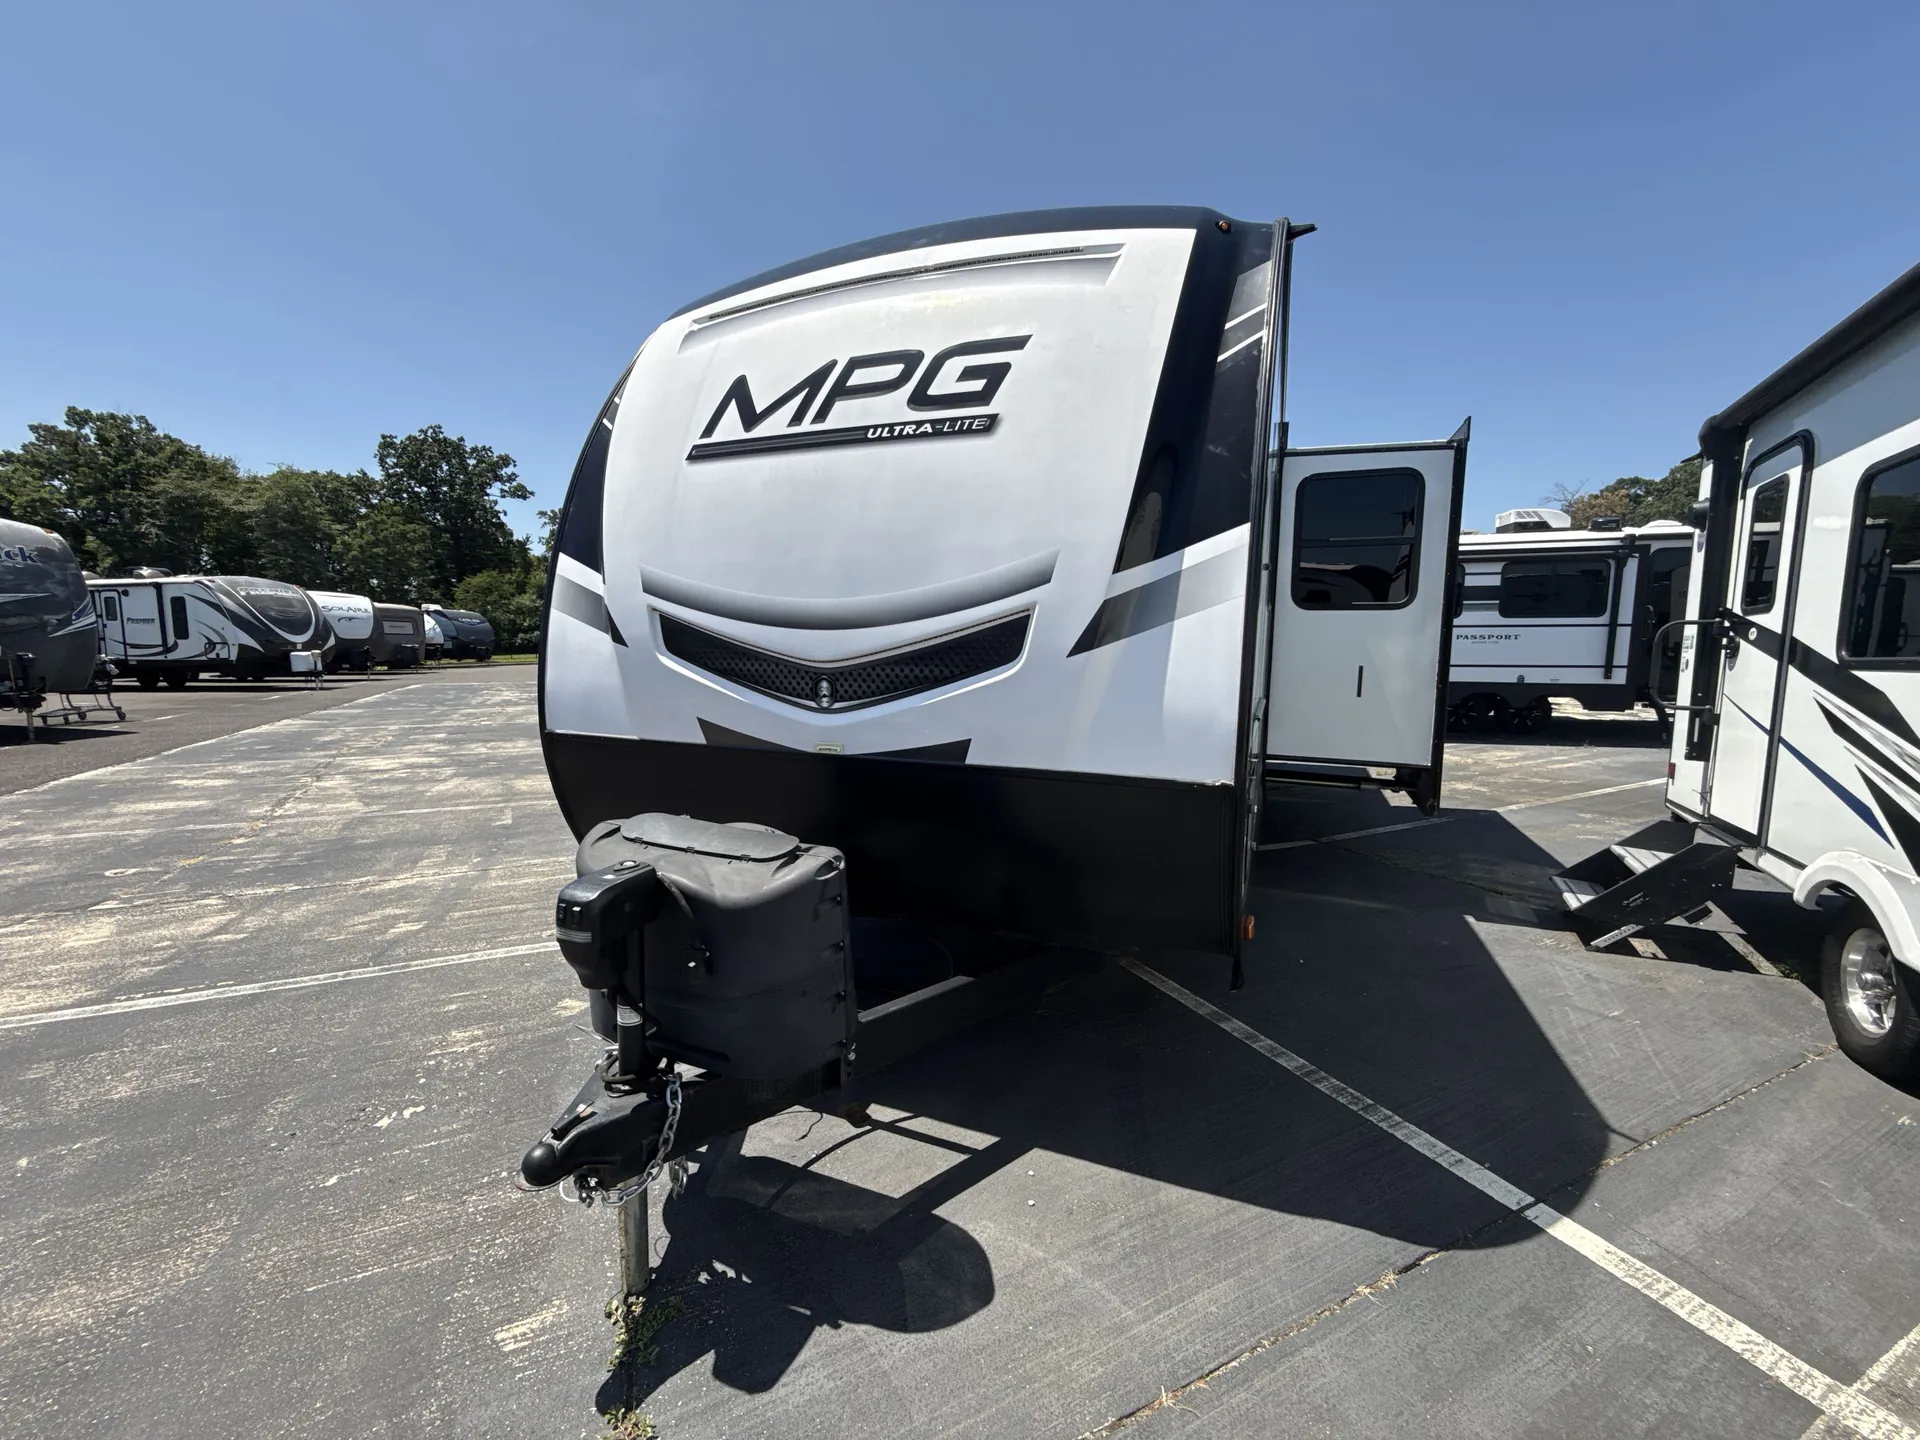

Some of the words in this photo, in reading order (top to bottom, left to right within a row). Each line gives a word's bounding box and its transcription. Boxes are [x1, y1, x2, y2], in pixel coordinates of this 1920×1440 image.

[698, 334, 1034, 440] MPG
[866, 417, 988, 439] ULTRA-LITE
[0, 545, 40, 564] ck
[321, 605, 371, 614] SOLAIRE
